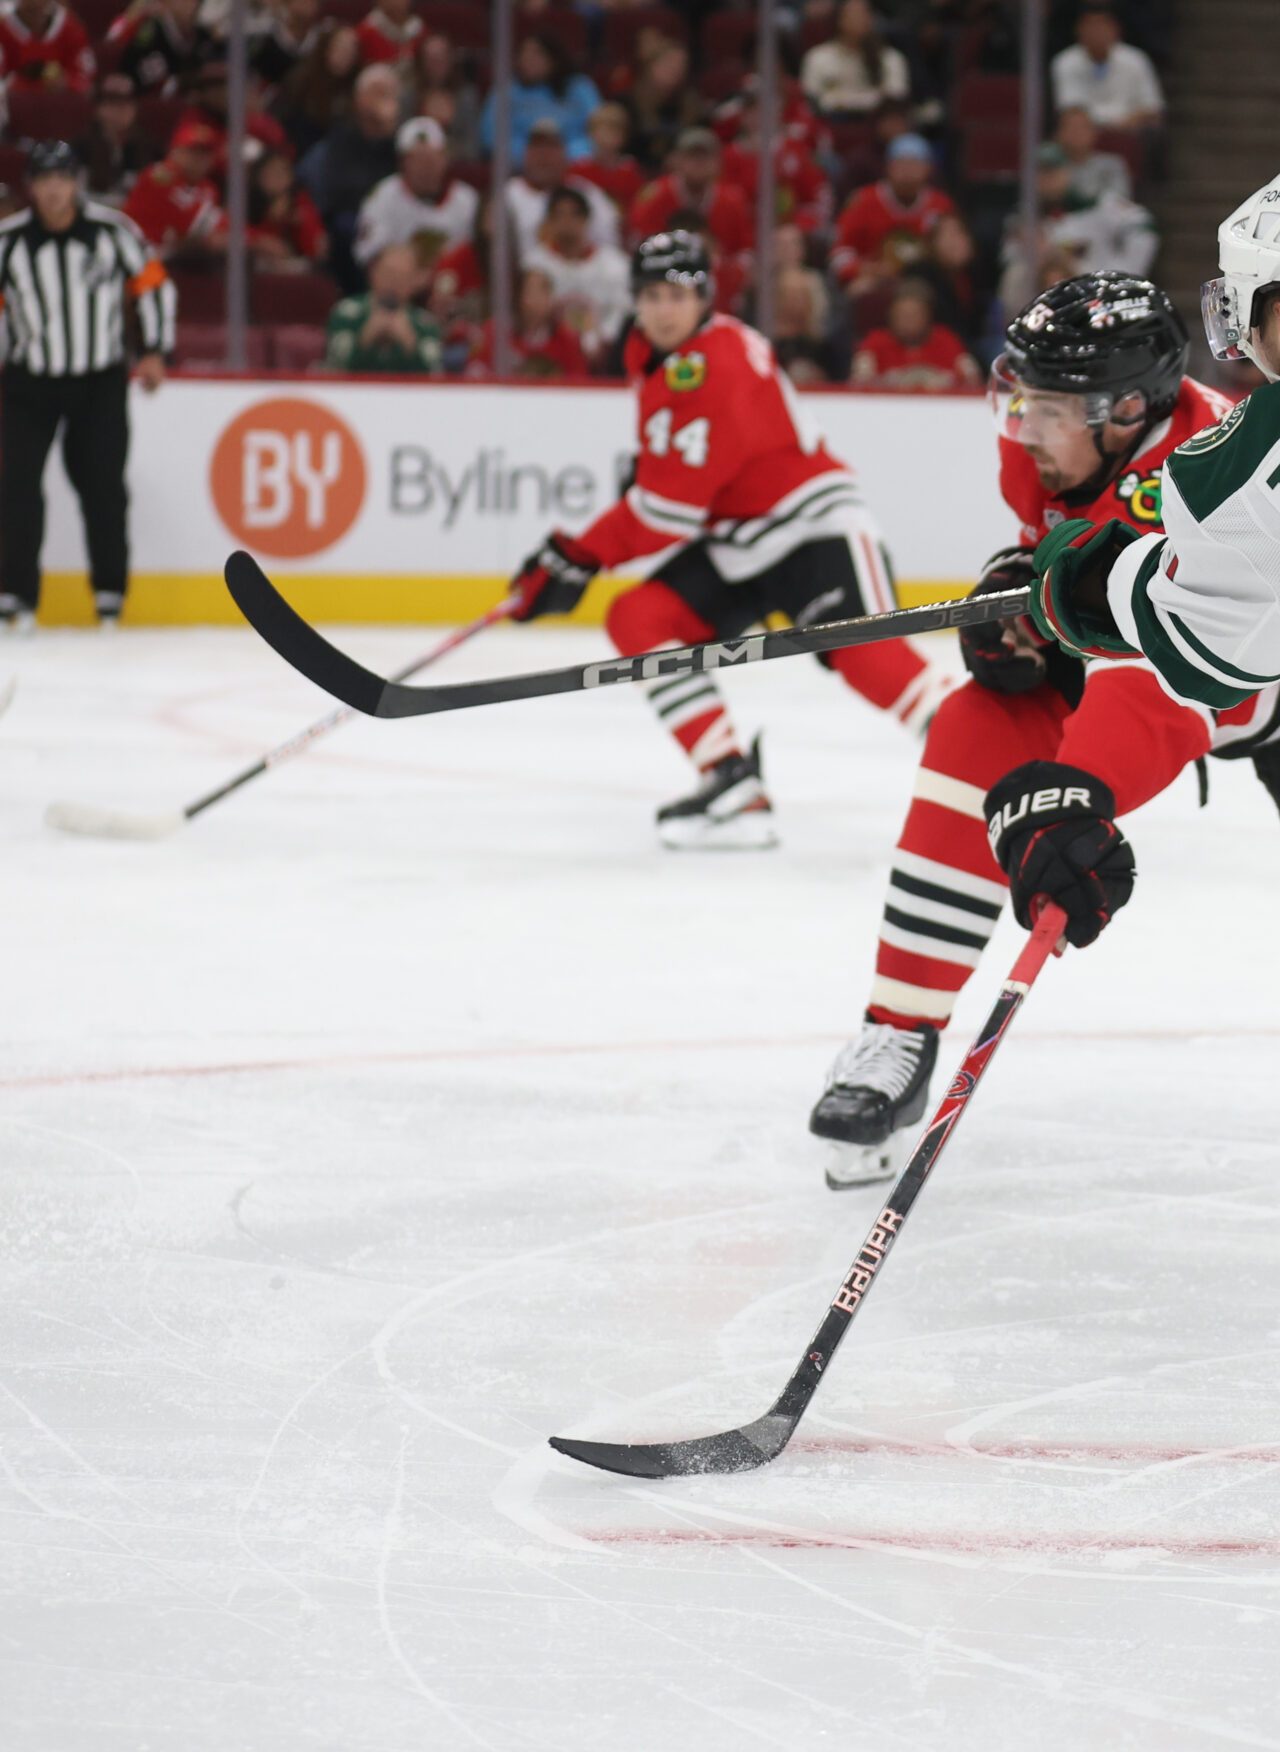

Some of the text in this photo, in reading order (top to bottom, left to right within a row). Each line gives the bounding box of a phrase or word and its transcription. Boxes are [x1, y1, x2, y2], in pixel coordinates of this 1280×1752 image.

[645, 408, 710, 467] 44
[243, 431, 342, 529] BY
[389, 445, 596, 530] Byline
[925, 596, 1031, 629] JETS
[583, 636, 764, 689] CCM
[987, 787, 1091, 864] AUER
